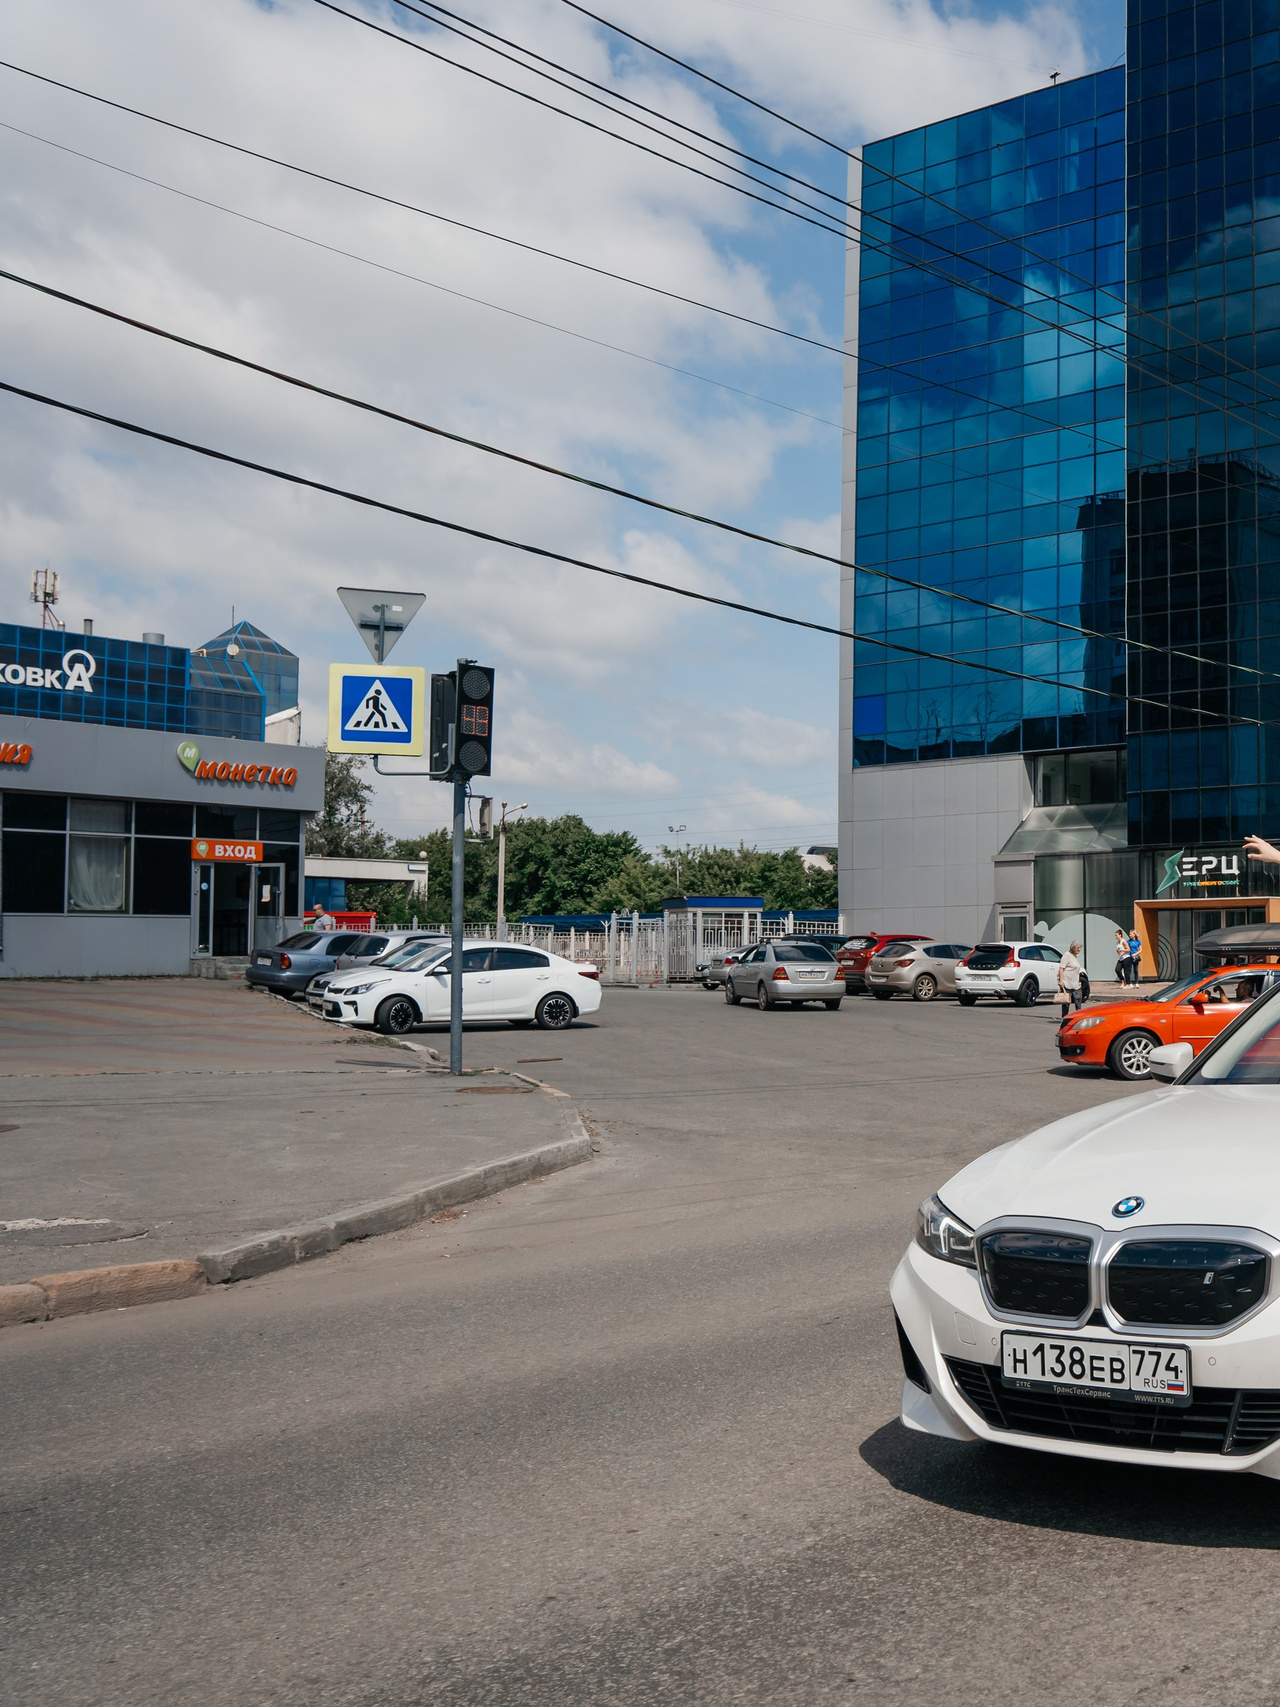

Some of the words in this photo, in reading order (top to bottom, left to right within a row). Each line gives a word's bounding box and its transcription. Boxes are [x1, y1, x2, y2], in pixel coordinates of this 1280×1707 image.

[0, 742, 33, 764] ИЯ
[215, 845, 256, 859] ВХОД
[1182, 855, 1240, 875] ЕРЦ
[1012, 1343, 1126, 1384] Н138ЕВ
[1132, 1349, 1179, 1380] 774
[1143, 1378, 1166, 1389] RUS
[1053, 1385, 1111, 1398] ТрансТехСервис
[1134, 1394, 1175, 1404] WWW.TTS.RU
